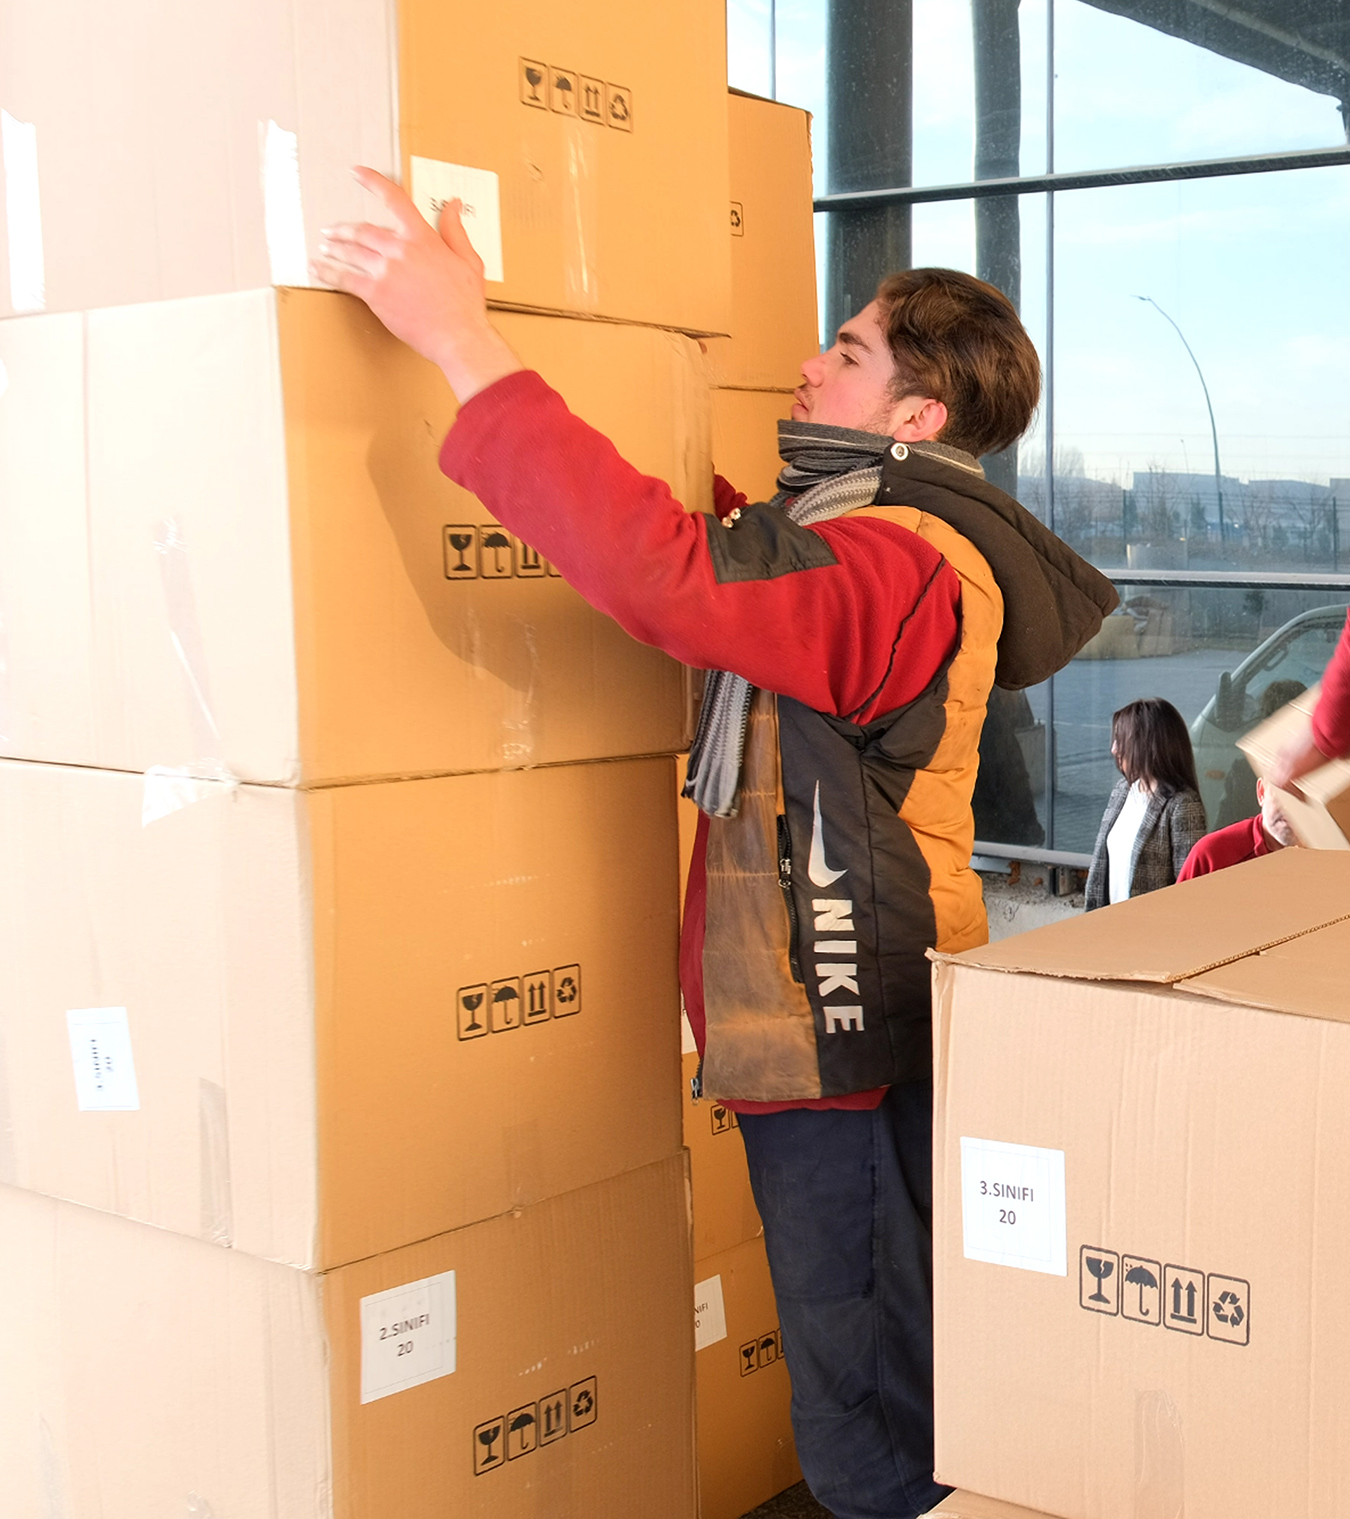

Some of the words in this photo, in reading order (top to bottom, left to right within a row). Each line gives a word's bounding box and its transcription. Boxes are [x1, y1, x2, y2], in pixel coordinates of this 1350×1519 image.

[811, 898, 866, 1034] NIKE
[979, 1180, 1034, 1202] 3.SINIFI
[999, 1208, 1017, 1225] 20
[694, 1302, 709, 1314] NIFI
[379, 1313, 430, 1341] 2.SINIFI
[397, 1340, 414, 1357] 20
